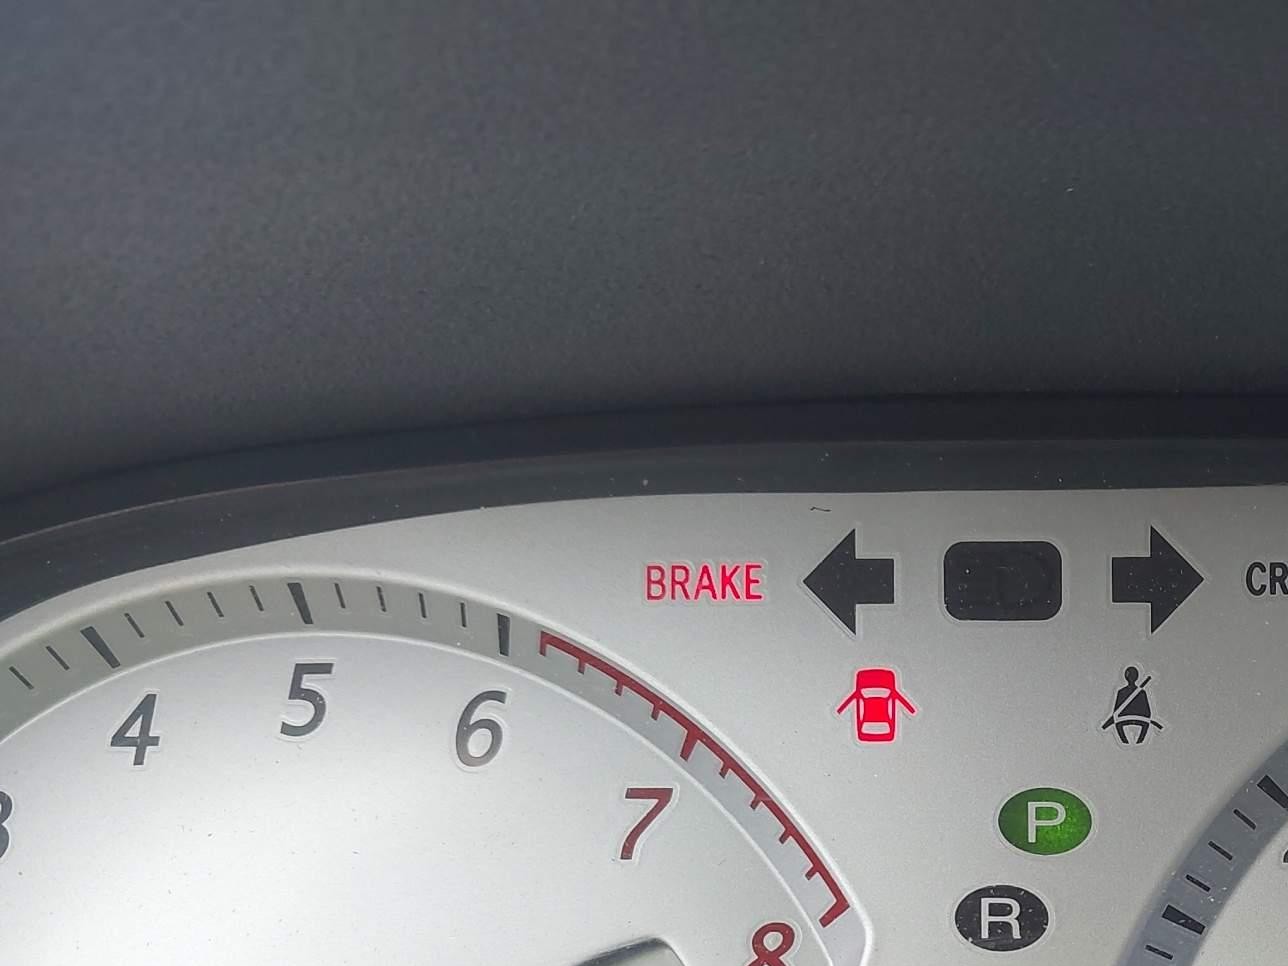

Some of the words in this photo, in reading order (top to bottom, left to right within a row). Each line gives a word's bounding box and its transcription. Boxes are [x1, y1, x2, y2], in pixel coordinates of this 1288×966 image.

[647, 565, 762, 600] BRAKE
[111, 694, 159, 765] 4
[281, 663, 334, 736] 5
[456, 690, 506, 766] 6
[621, 788, 673, 860] 7
[1028, 802, 1066, 842] P
[981, 898, 1021, 938] R
